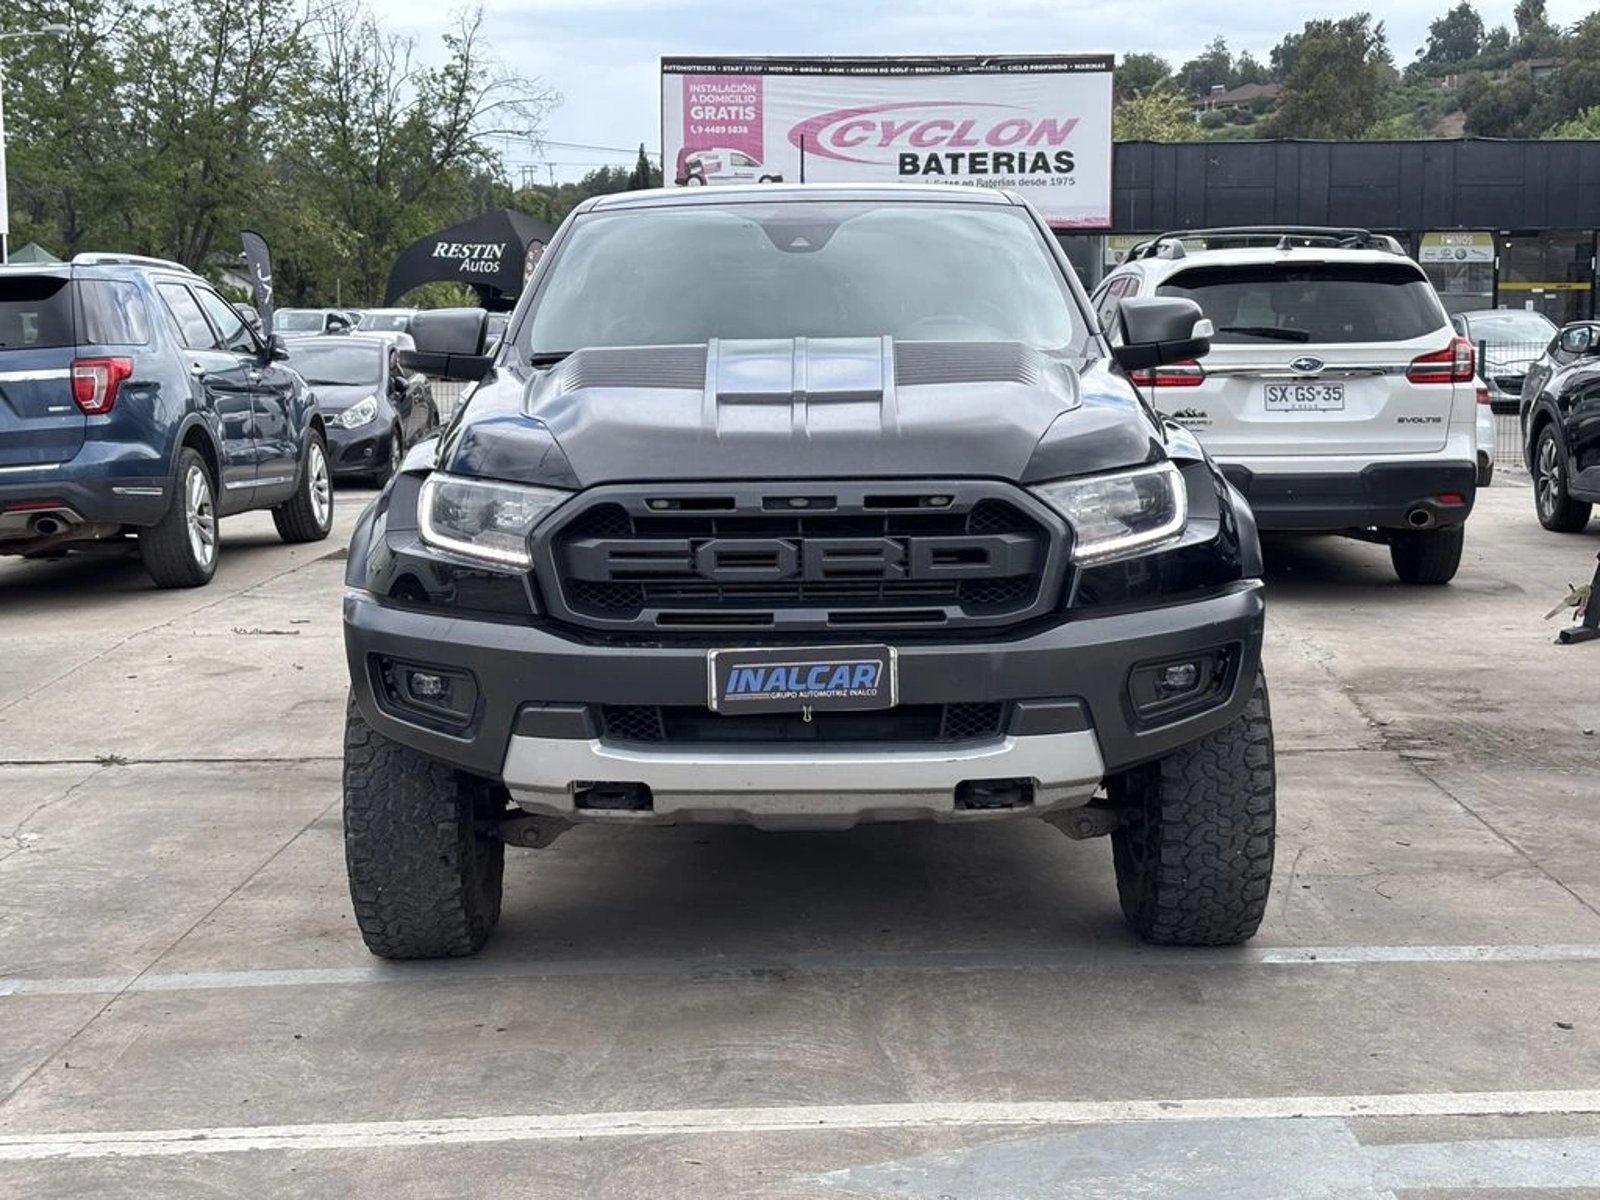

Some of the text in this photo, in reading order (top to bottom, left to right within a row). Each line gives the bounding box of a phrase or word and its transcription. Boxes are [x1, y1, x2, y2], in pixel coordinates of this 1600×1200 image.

[1030, 63, 1068, 71] PROFUNDO
[689, 83, 756, 93] INSTALACIÓN
[690, 95, 756, 103] A DOMICILIO
[690, 106, 756, 120] GRATIS
[696, 125, 703, 134] 9
[830, 118, 1080, 148] CYCLON
[1018, 177, 1048, 187] desde
[1050, 177, 1076, 186] 1975
[432, 242, 506, 259] RESTIN
[459, 258, 500, 273] Autos
[566, 536, 1034, 582] FORD
[726, 664, 876, 693] INALCAR
[770, 688, 878, 699] GRUPO AUTOMOTRIZ INALCO
